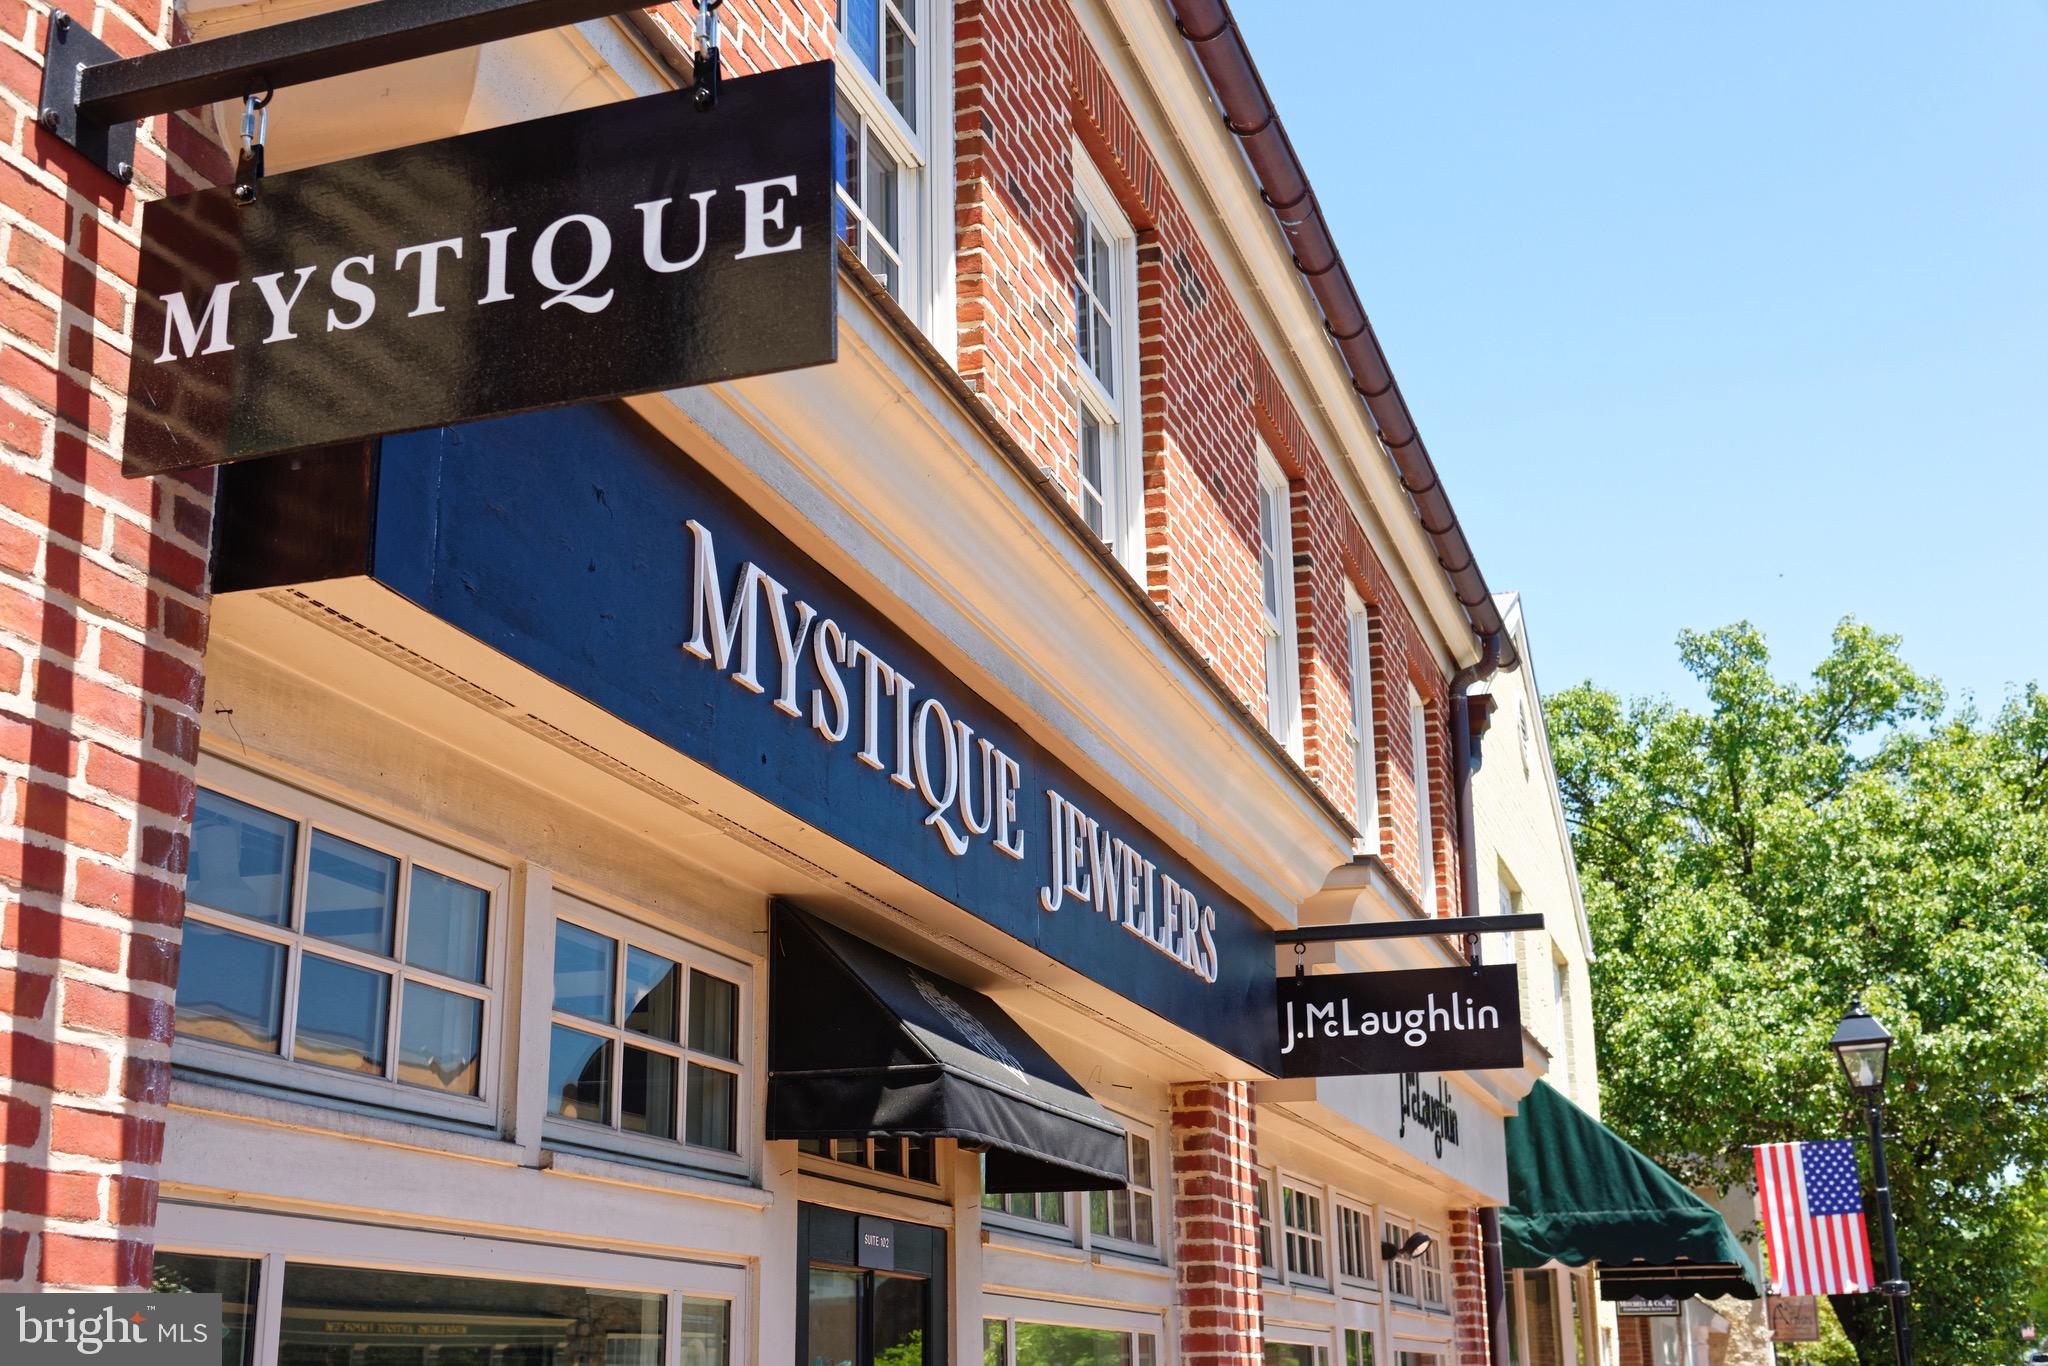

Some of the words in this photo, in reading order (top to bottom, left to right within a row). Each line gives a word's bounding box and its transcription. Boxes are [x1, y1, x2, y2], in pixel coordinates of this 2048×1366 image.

[153, 175, 802, 364] MYSTIQUE
[683, 519, 1025, 860] MYSTIQUE
[1041, 789, 1219, 984] JEWELERS
[864, 1233, 880, 1247] SUITE
[880, 1236, 890, 1248] 102
